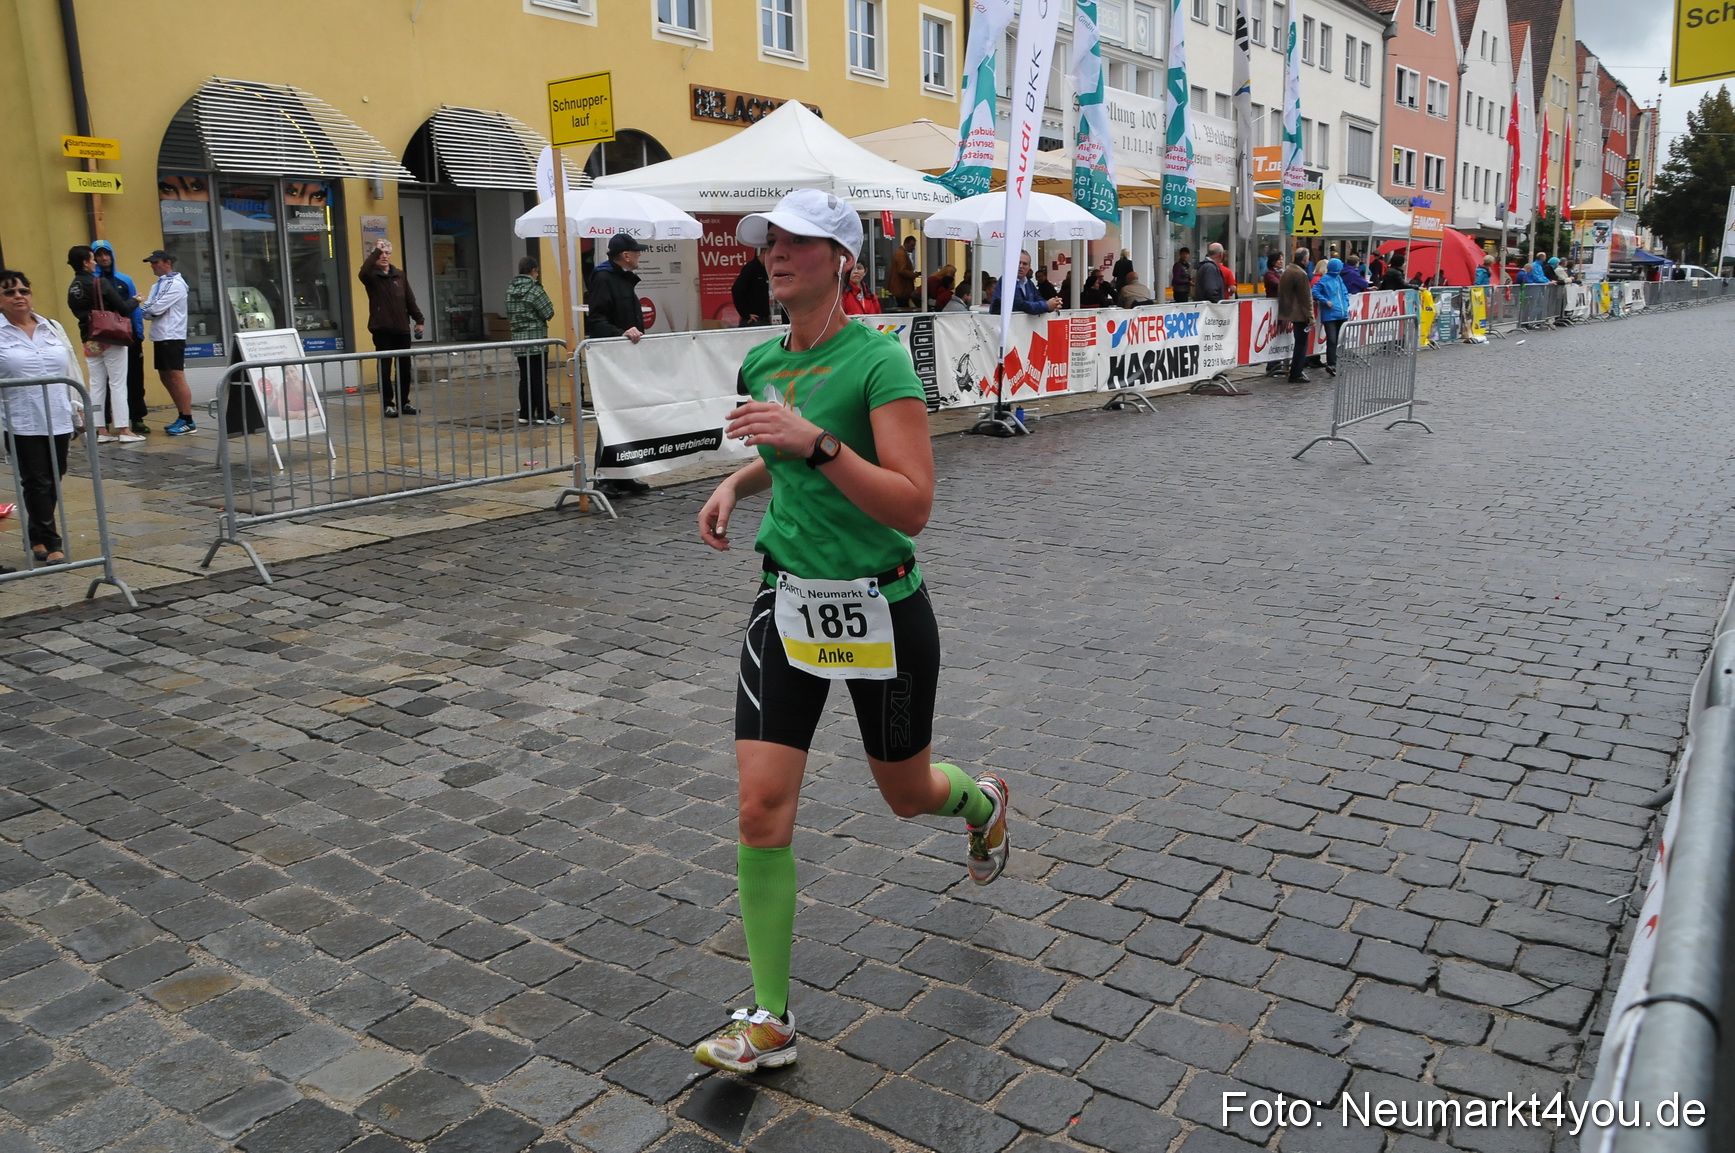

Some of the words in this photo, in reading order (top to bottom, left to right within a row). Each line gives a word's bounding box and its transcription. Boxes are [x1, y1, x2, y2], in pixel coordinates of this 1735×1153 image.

[552, 94, 608, 112] Schnupper-
[571, 112, 590, 128] lauf
[1016, 119, 1033, 199] Audi
[1025, 42, 1042, 114] BKK
[1141, 110, 1157, 130] 100
[79, 149, 105, 158] ausgabe
[77, 177, 113, 188] Toiletten
[699, 187, 797, 199] www.audibkk.d
[848, 185, 869, 198] Von
[873, 188, 895, 201] uns,
[896, 187, 909, 200] für
[912, 190, 931, 202] uns:
[1298, 191, 1321, 201] Block
[295, 210, 324, 218] Passbilder
[1091, 197, 1113, 215] 352
[1299, 203, 1316, 226] A
[589, 225, 615, 235] Audi
[618, 227, 641, 237] BKK
[656, 243, 677, 253] sich!
[701, 250, 748, 267] Wert!
[1126, 312, 1200, 346] INTERSPORT
[1107, 344, 1200, 390] HACKNER
[616, 447, 657, 462] Leistungen,
[658, 443, 673, 455] die
[675, 436, 717, 452] verbinden
[807, 589, 864, 599] Neumarkt
[796, 602, 868, 639] 185
[817, 647, 855, 664] Anke
